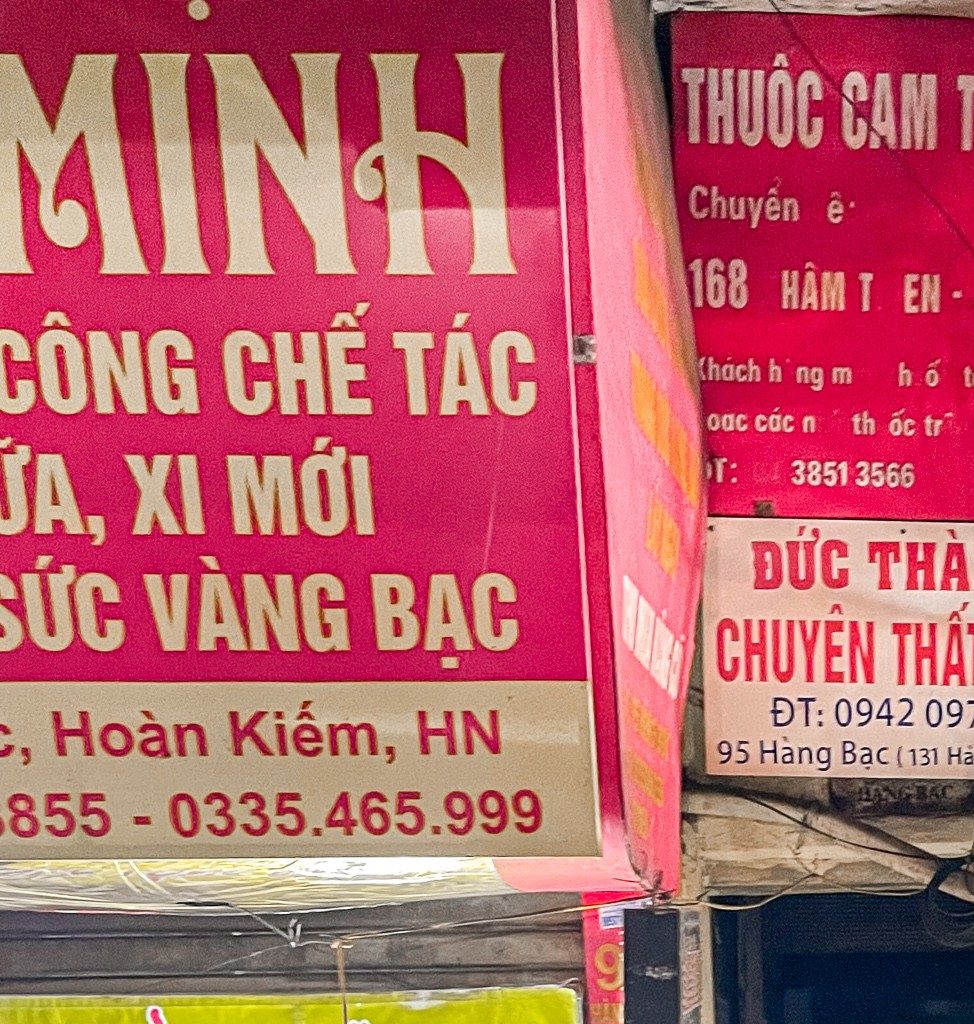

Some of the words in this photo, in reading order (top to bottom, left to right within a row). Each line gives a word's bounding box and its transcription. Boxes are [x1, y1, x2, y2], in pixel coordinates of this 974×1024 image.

[842, 71, 937, 150] CAM
[0, 53, 517, 275] MINH
[689, 258, 748, 309] 168
[781, 262, 846, 311] HÂM
[0, 312, 199, 415] CÔNG
[222, 303, 372, 415] CHẾ
[393, 313, 537, 416] TÁC
[754, 406, 795, 433] các
[123, 455, 205, 536] XI
[226, 437, 375, 536] MỚI
[791, 460, 848, 486] 3851
[855, 461, 915, 488] 3566
[751, 526, 849, 590] ĐỨC
[144, 556, 350, 652] VÀNG
[371, 572, 519, 669] BẠC
[716, 604, 875, 684] CHUYÊN
[51, 710, 208, 758] Hoàn
[230, 702, 396, 764] Kiếm,
[418, 710, 502, 756] HN
[770, 696, 823, 728] ĐT:
[835, 697, 914, 728] 0942
[717, 740, 750, 765] 95
[759, 736, 832, 772] Hàng
[842, 740, 889, 770] Bạc
[0, 792, 111, 838] 855
[168, 790, 543, 837] 0335.465.999
